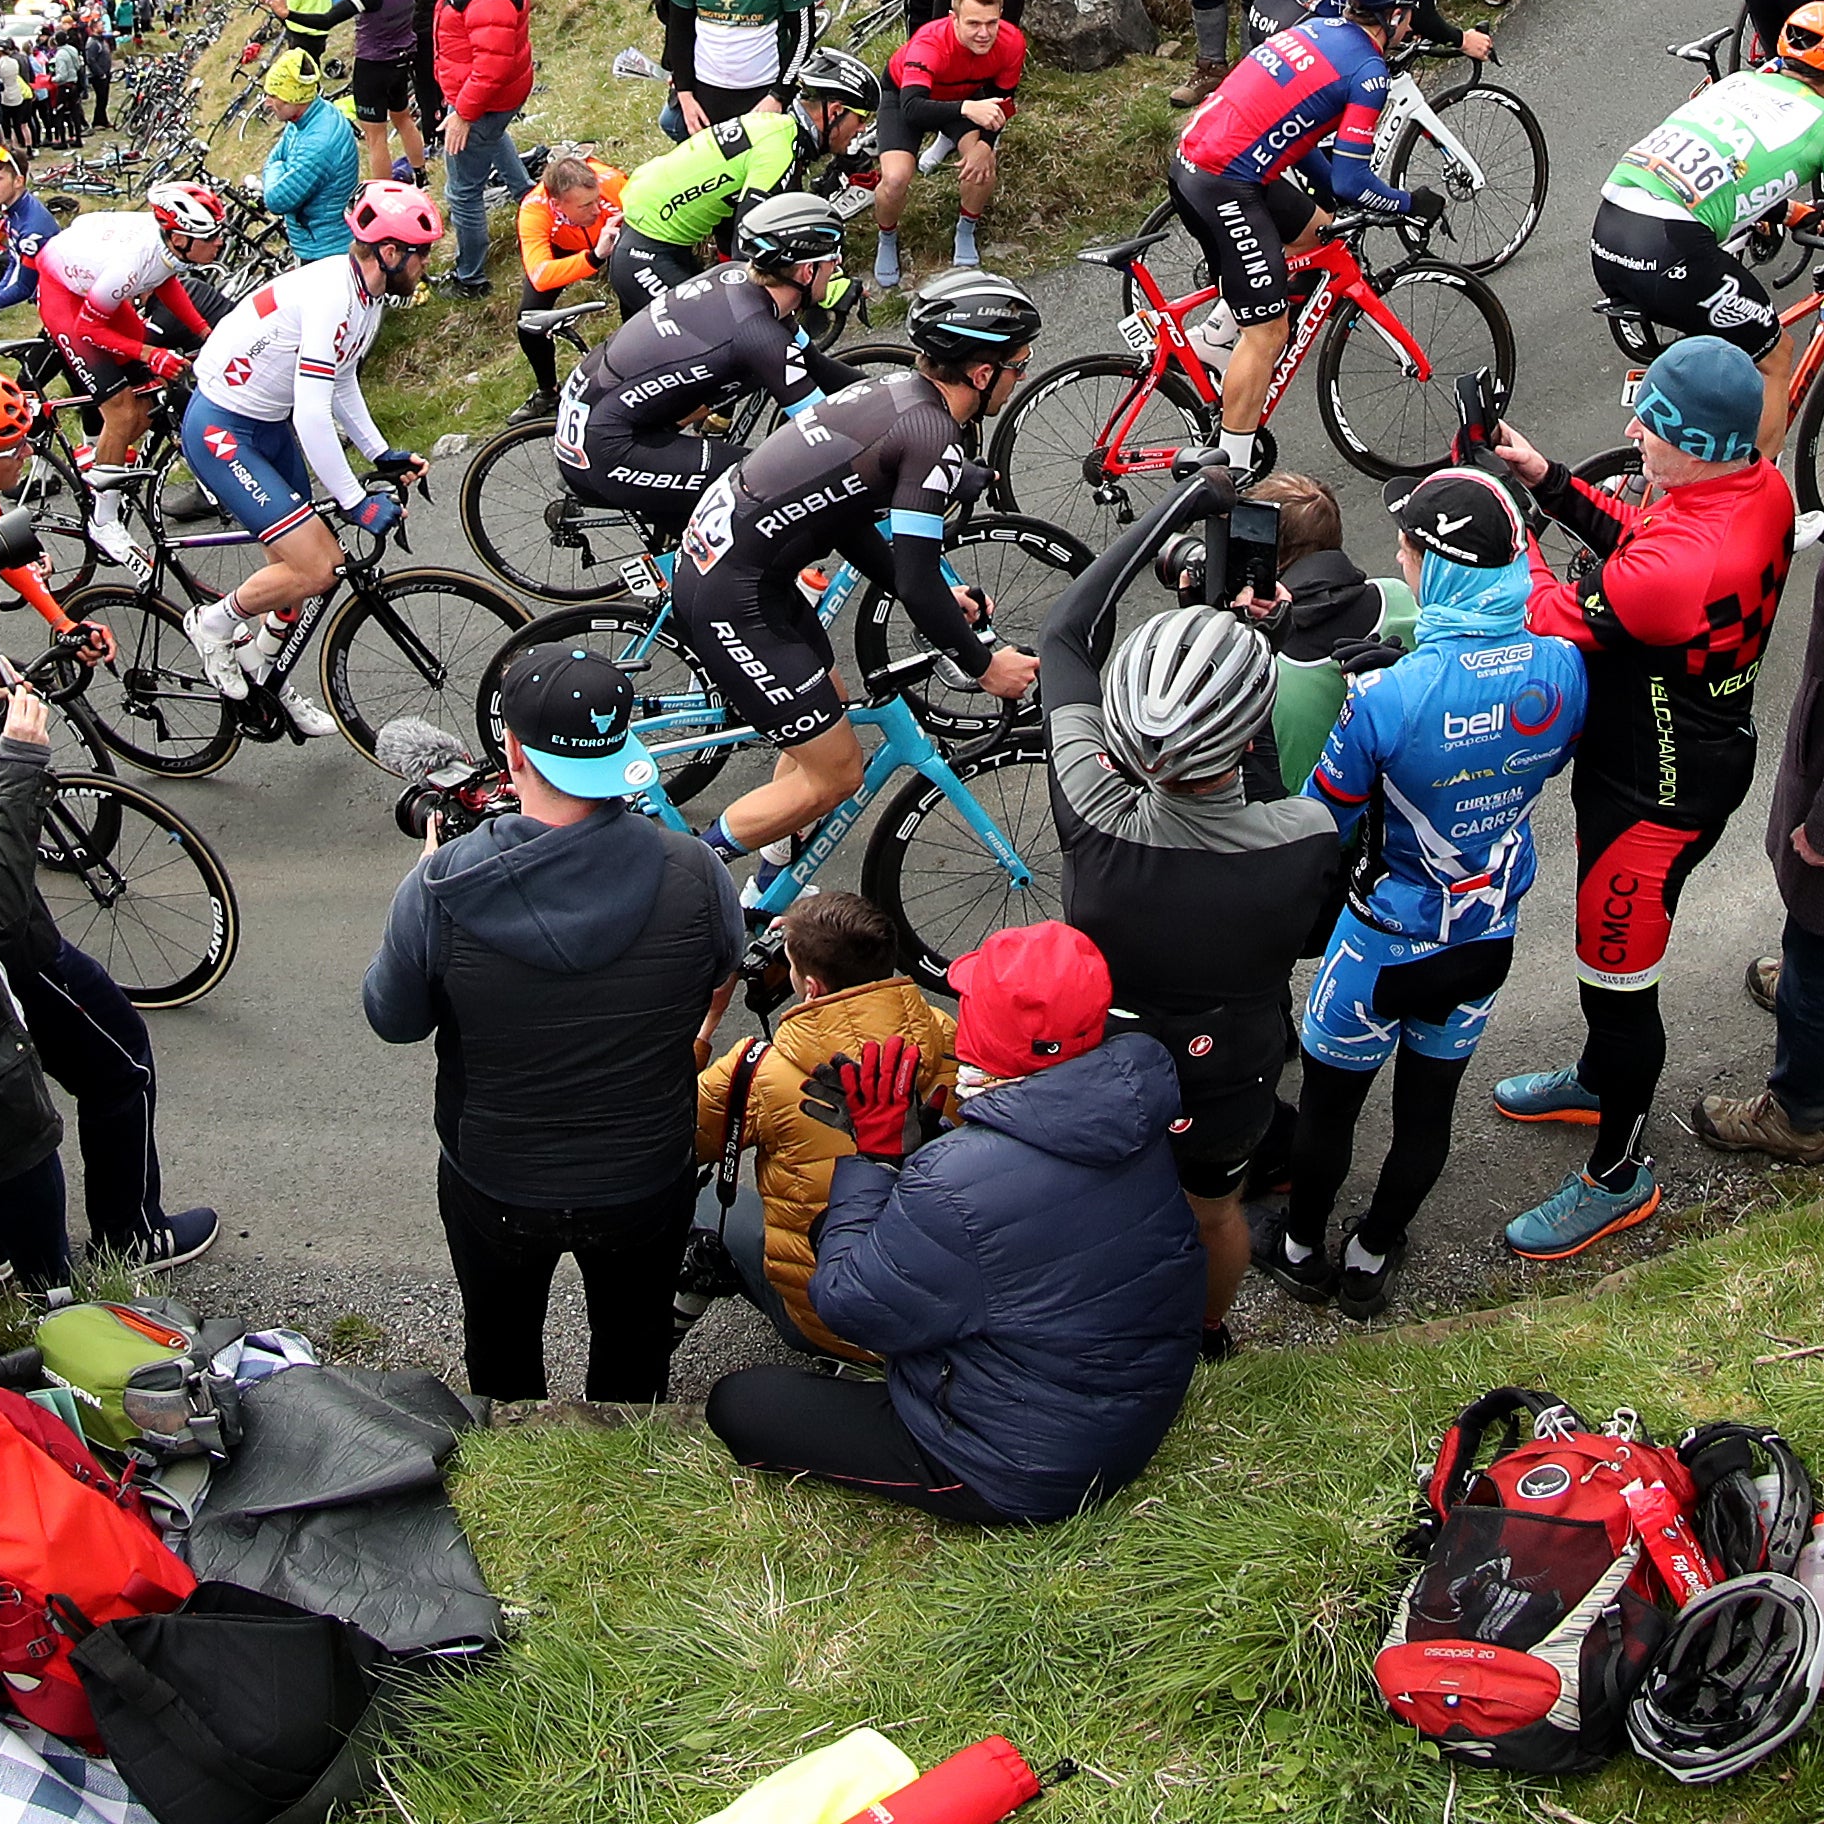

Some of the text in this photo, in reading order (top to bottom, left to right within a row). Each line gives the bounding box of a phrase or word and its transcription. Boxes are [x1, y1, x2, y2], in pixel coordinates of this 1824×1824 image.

[1466, 89, 1520, 110] ZIPP
[1268, 113, 1315, 149] COL
[1666, 134, 1724, 193] 136
[379, 196, 407, 216] EF
[659, 172, 735, 222] ORBEA
[1357, 188, 1400, 212] WIGGINS
[1735, 169, 1798, 222] ASDA
[1217, 200, 1272, 289] WIGGINS
[1392, 271, 1466, 291] ZIPP
[1233, 298, 1287, 320] LE COL
[1696, 275, 1776, 326] Roompot
[249, 335, 270, 359] HSBC
[1121, 322, 1147, 351] 103
[1262, 290, 1334, 414] PINARELLO
[58, 333, 97, 394] Cofidis
[620, 363, 714, 409] RIBBLE
[1635, 382, 1753, 462] Rab
[228, 459, 272, 507] HSBC UK
[607, 465, 707, 491] RIBBLE
[756, 473, 869, 539] RIBBLE
[125, 551, 149, 578] 181
[629, 559, 652, 591] 176
[383, 582, 457, 600] metron
[276, 593, 325, 672] cannondale
[710, 621, 795, 707] RIBBLE
[1460, 642, 1534, 670] VERGE
[781, 707, 831, 739] COL
[1444, 703, 1505, 740] bell
[551, 734, 605, 749] EL TORO
[56, 787, 113, 800] IANT
[1455, 786, 1524, 812] CHRYSTAL
[793, 784, 872, 884] RIBBLE
[1451, 806, 1519, 839] CARRS
[208, 895, 225, 965] GIANT
[1598, 873, 1640, 967] CMCC
[1329, 1050, 1385, 1062] GIANT
[1670, 1554, 1707, 1598] Fig Rolls
[1424, 1647, 1496, 1660] escapist 20
